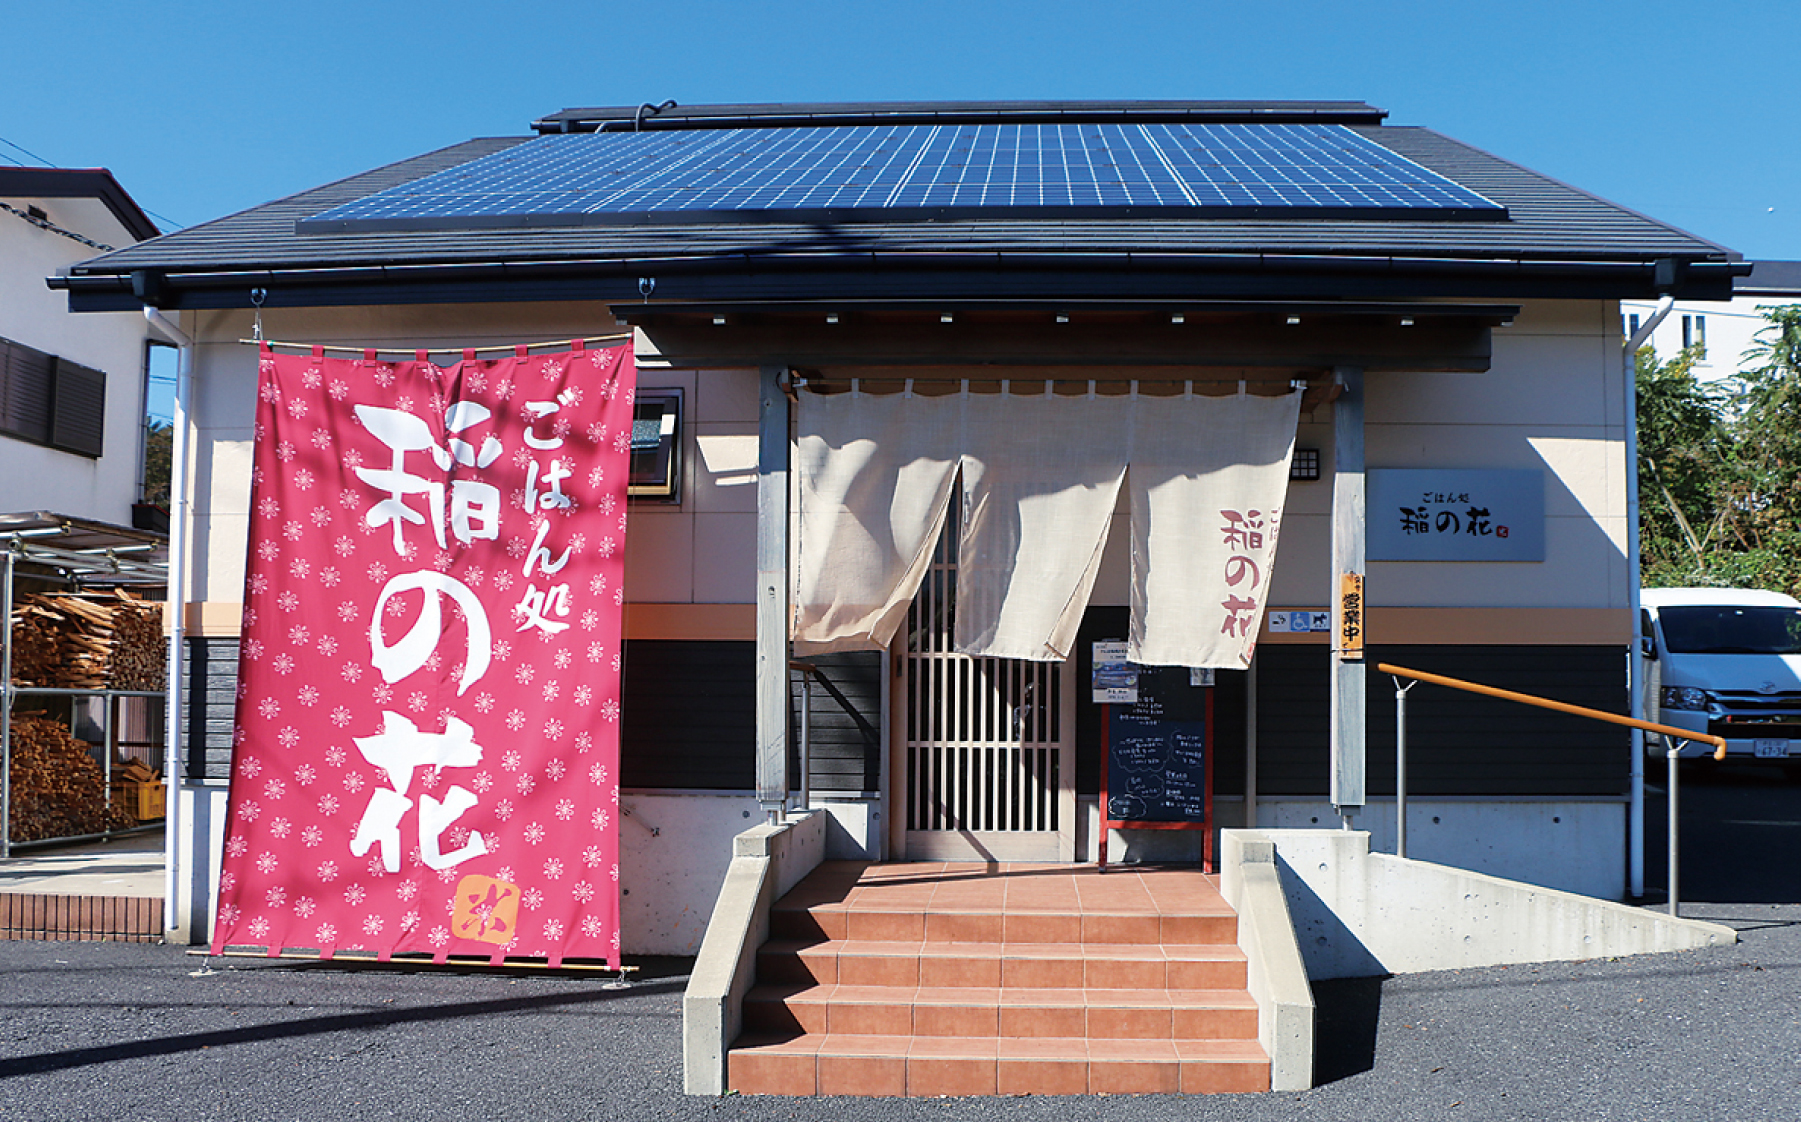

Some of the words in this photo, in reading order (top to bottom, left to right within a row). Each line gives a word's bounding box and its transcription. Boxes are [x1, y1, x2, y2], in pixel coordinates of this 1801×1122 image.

[515, 389, 579, 634] ごはん処
[1399, 506, 1493, 537] 稲の花
[349, 401, 502, 873] 稲の花
